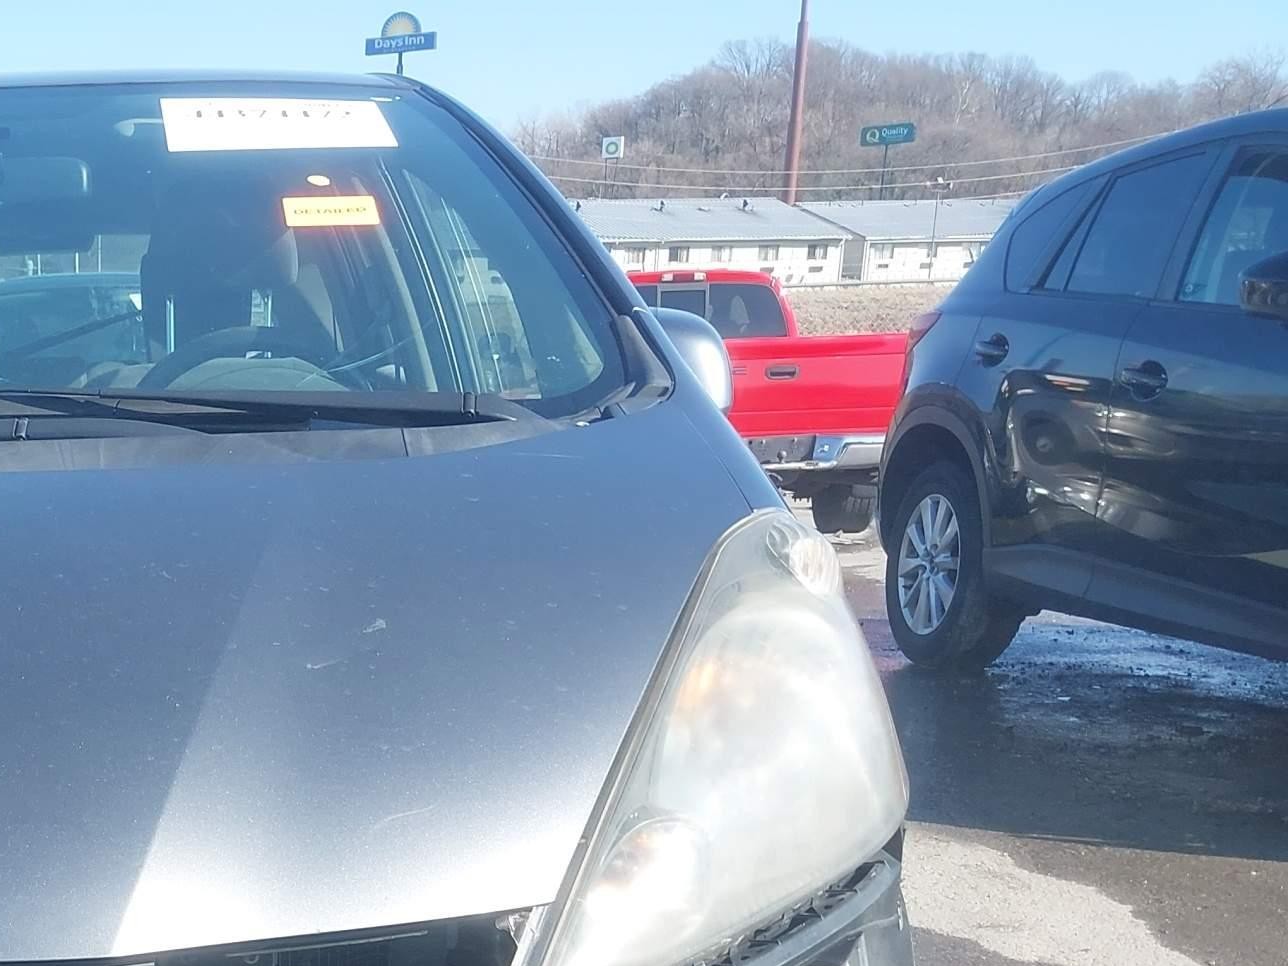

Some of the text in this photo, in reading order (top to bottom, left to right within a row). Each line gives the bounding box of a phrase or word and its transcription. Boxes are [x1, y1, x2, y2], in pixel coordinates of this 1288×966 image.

[374, 35, 425, 49] Days Inn
[881, 127, 909, 137] Quality
